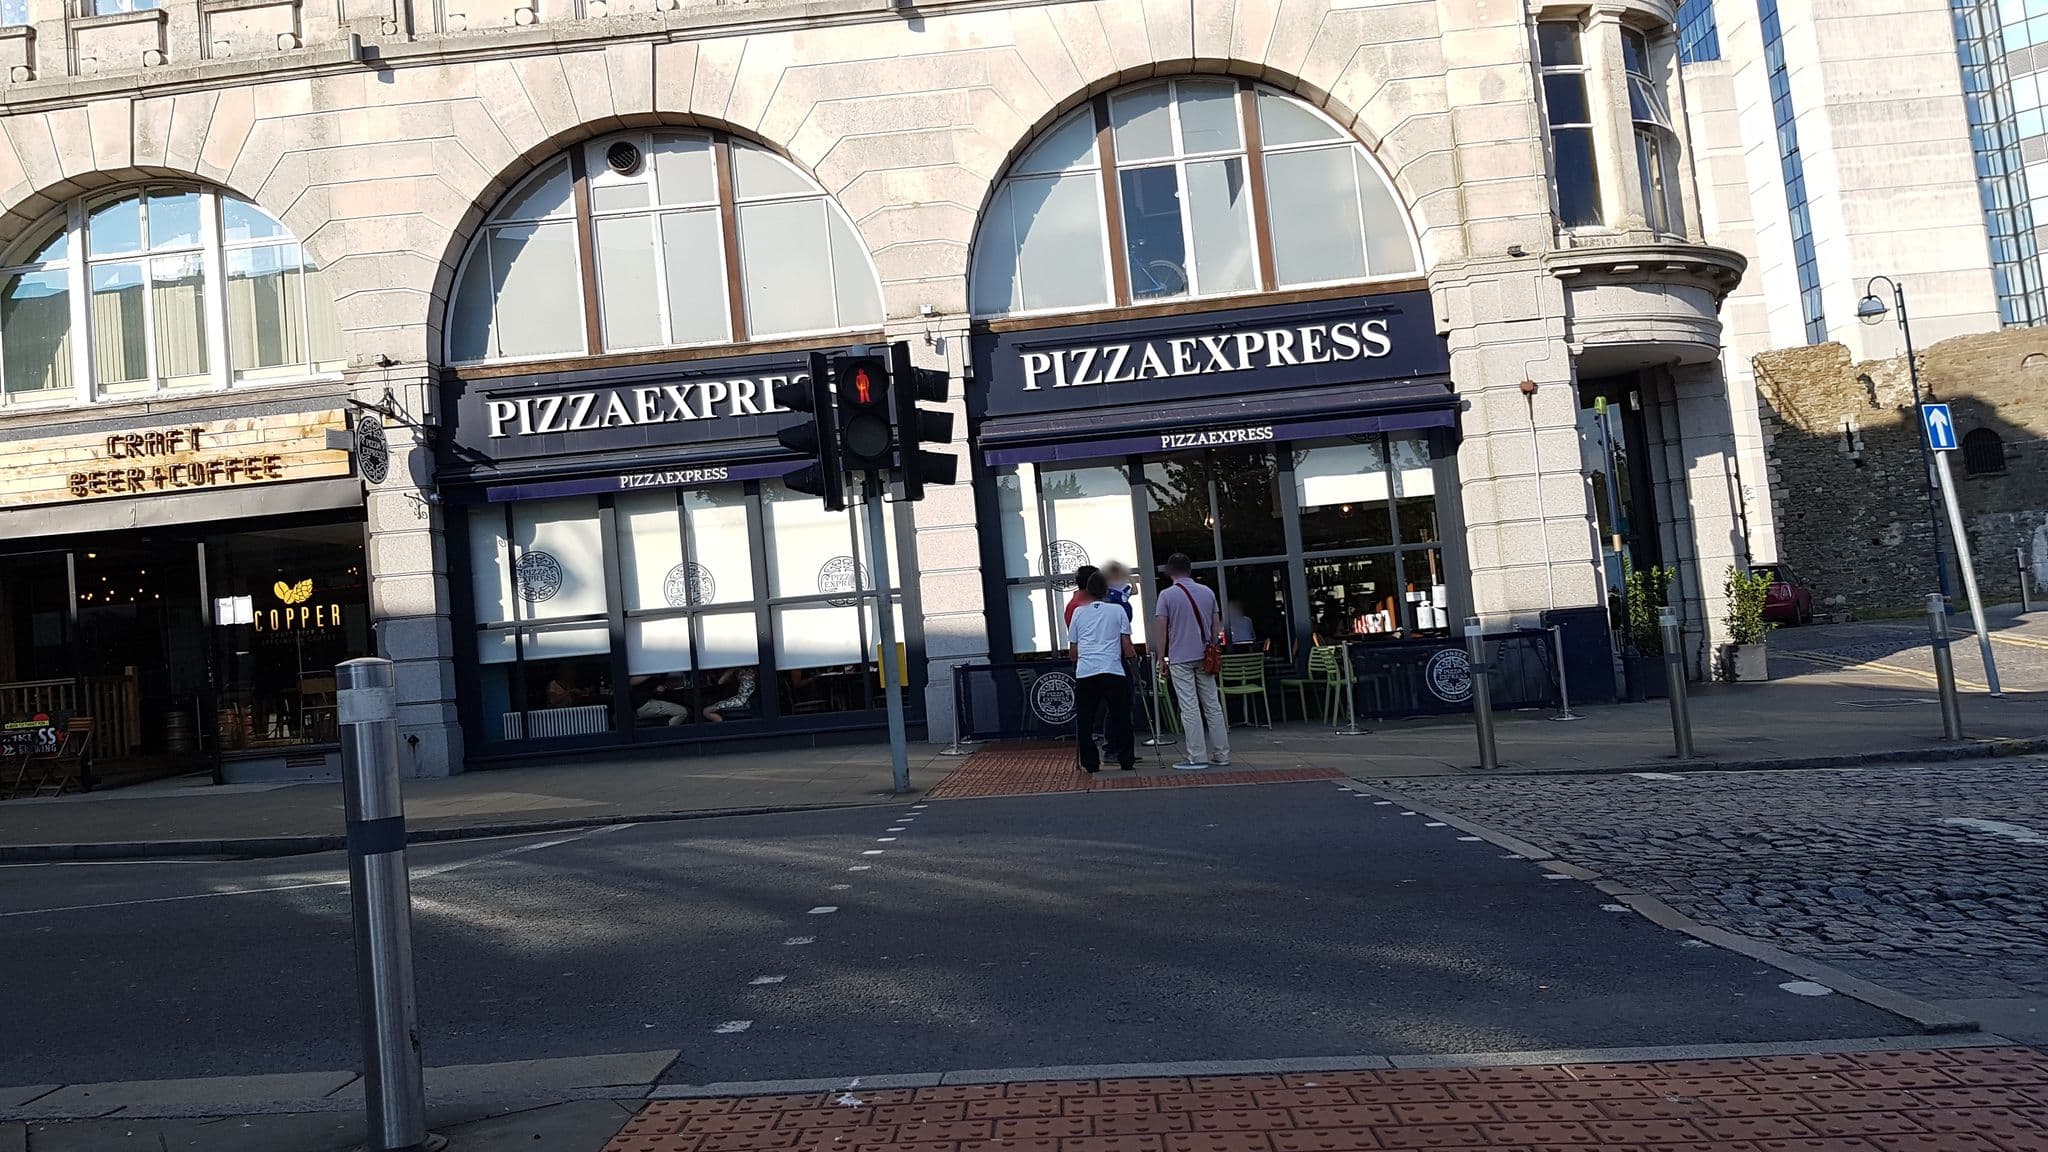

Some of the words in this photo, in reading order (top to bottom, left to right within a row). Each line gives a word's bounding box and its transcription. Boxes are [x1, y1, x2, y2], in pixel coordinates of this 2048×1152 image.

[1019, 319, 1392, 391] PIZZAEXPRESS
[485, 373, 811, 438] PIZZAEXPRE
[107, 427, 205, 460] CRAFT
[1160, 426, 1273, 448] PIZZAEXPRESS
[620, 466, 728, 489] PIZZAEXPRESS
[522, 573, 557, 583] XPRESS
[831, 573, 851, 581] PIZZ
[254, 603, 341, 632] COPPER
